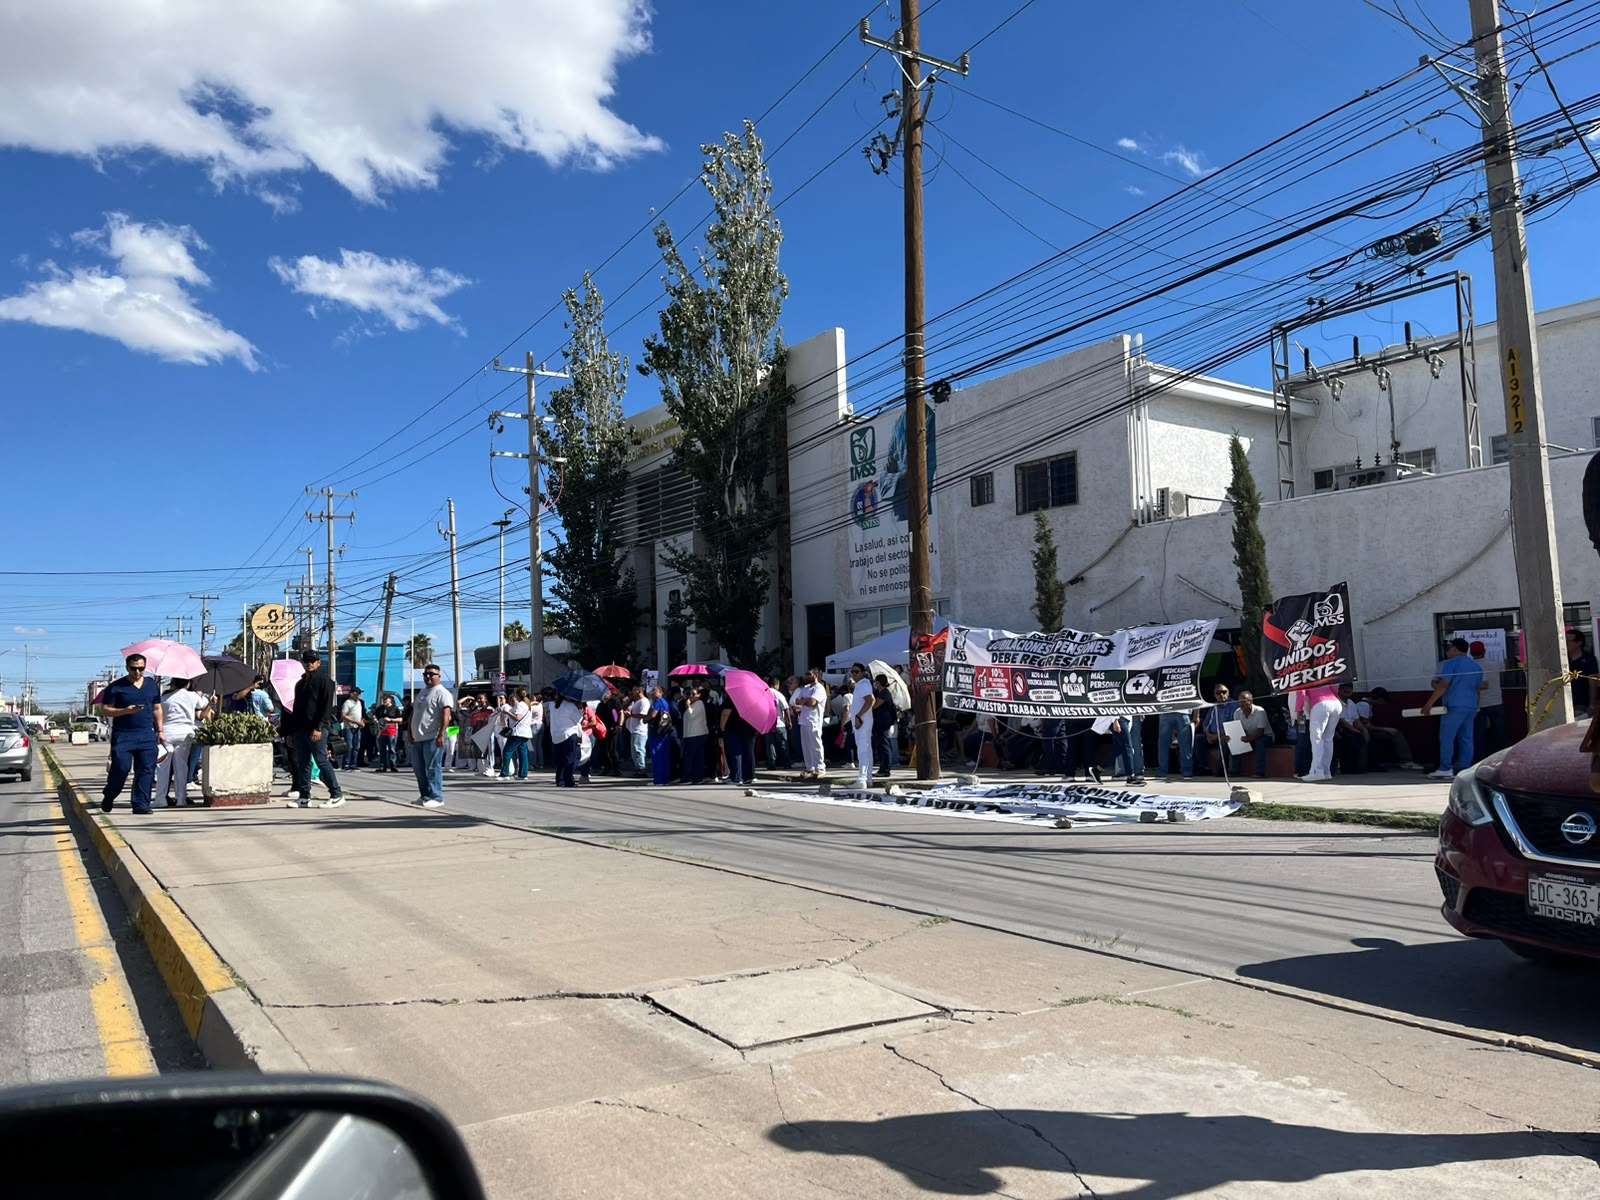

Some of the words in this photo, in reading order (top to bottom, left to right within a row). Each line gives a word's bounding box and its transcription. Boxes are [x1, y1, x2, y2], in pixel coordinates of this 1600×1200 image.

[850, 461, 876, 481] IMSS
[855, 542, 863, 553] La
[864, 539, 885, 550] salud,
[850, 556, 873, 568] trabajo
[876, 552, 886, 563] del
[888, 550, 909, 560] secto
[868, 569, 877, 579] No
[880, 568, 888, 577] se
[860, 586, 867, 596] ni
[869, 585, 877, 594] se
[1314, 613, 1345, 629] IMSS
[950, 649, 968, 662] IMSS
[991, 653, 1018, 664] DEBE
[1020, 652, 1097, 669] REGRESAR!
[1273, 639, 1336, 671] UNIDOS
[991, 667, 1005, 678] 10%
[1272, 658, 1347, 691] FUERTES
[1276, 662, 1310, 677] SOMOS
[1089, 681, 1121, 689] PERSONAL
[976, 701, 1007, 714] NUESTRO
[1008, 703, 1051, 717] TRABAJO,
[1051, 706, 1098, 717] NUESTRA
[1099, 705, 1157, 716] DIGNIDAD!
[1534, 904, 1596, 926] JIDOSHA
